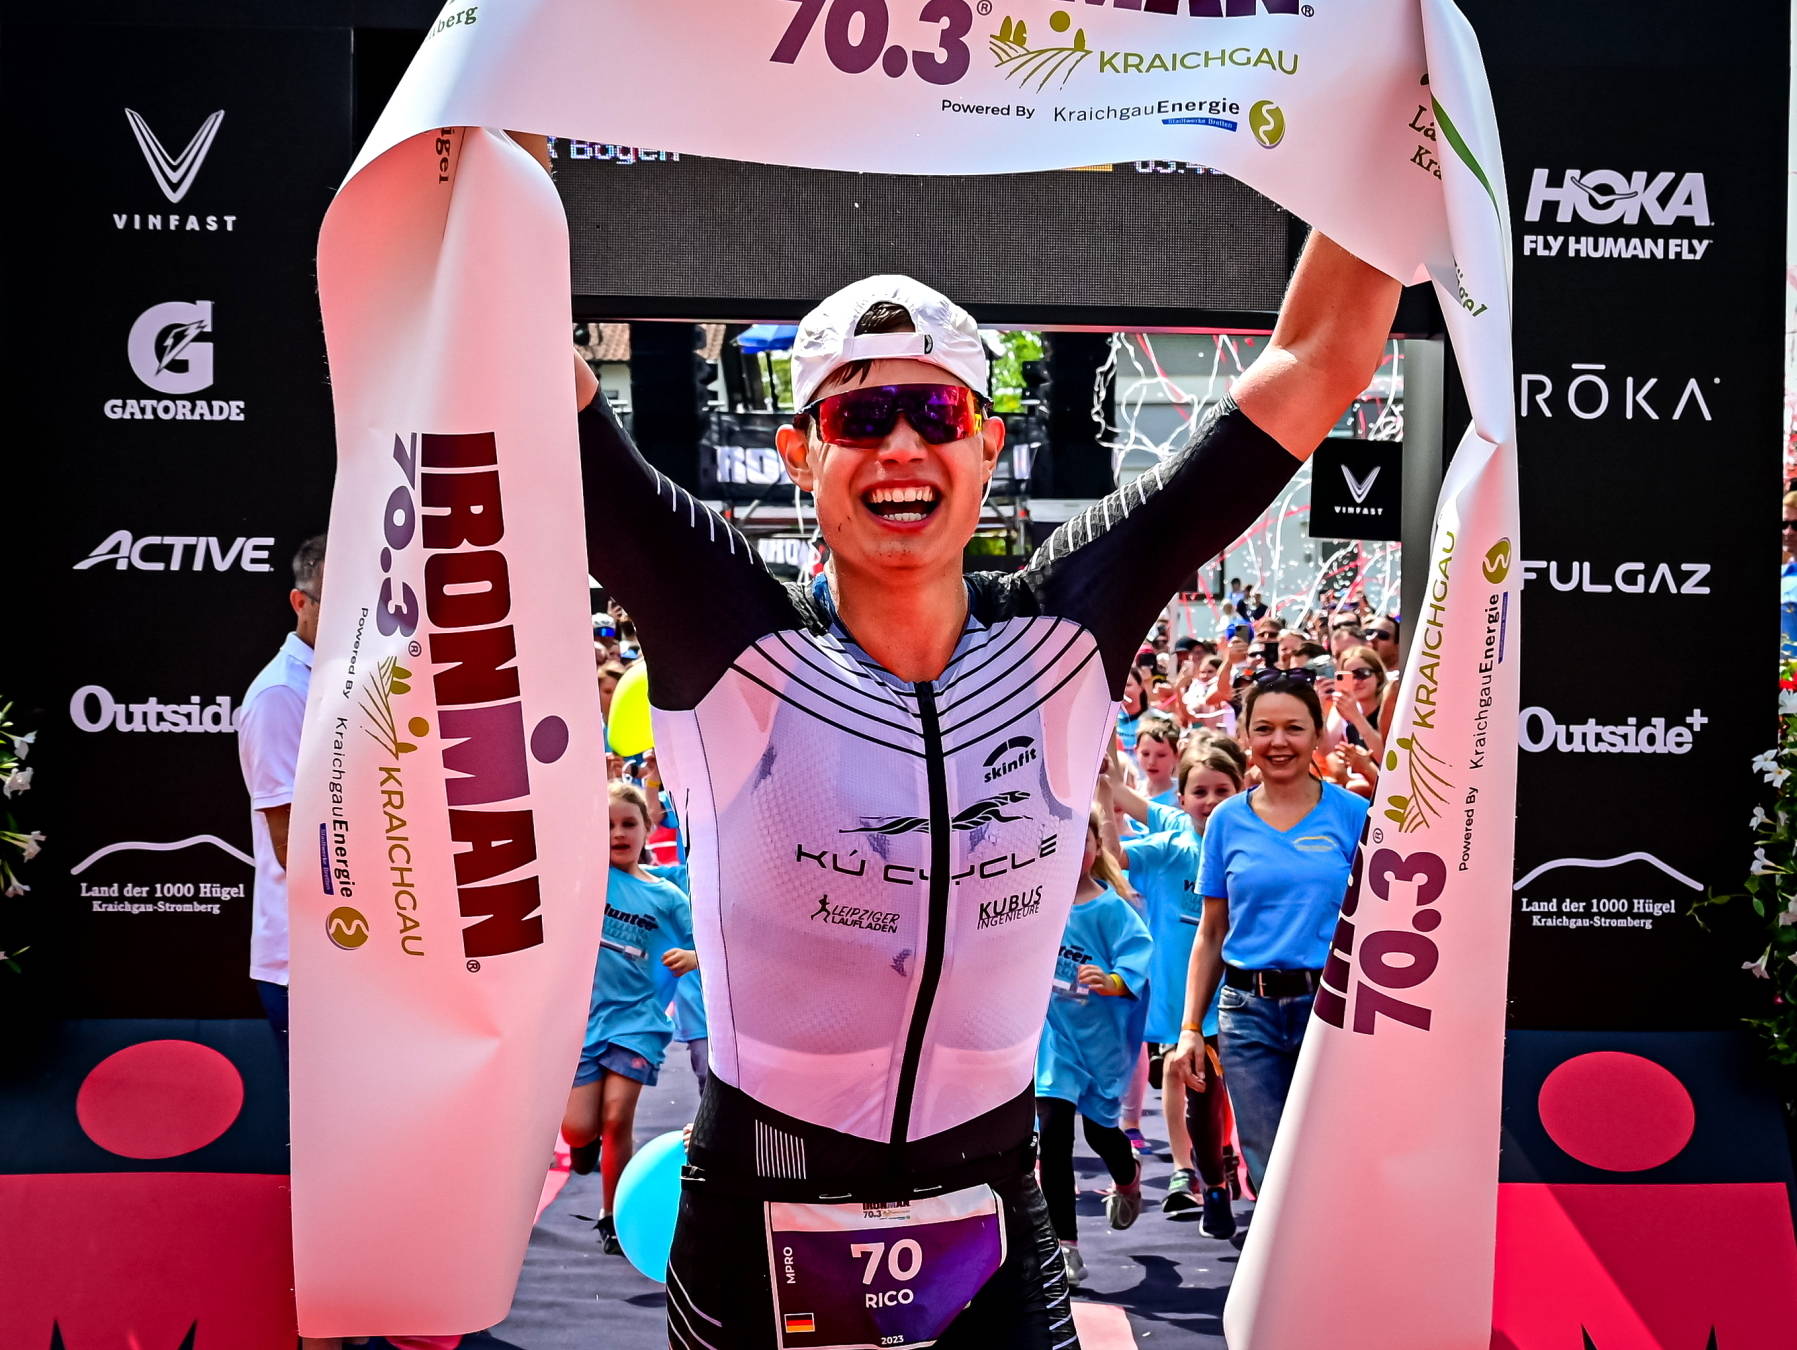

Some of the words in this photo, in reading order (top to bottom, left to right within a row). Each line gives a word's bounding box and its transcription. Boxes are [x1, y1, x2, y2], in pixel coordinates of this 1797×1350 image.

[1099, 47, 1299, 76] KRAICHGAU
[941, 99, 1011, 117] Powered
[1016, 105, 1036, 120] By
[1053, 97, 1240, 122] KraichgauEnergie
[1524, 168, 1711, 226] HOKA
[113, 214, 237, 231] VINFAST
[1523, 235, 1564, 256] FLY
[1568, 236, 1664, 259] HUMAN
[1668, 239, 1710, 260] FLY
[104, 400, 246, 421] GATORADE
[1334, 505, 1383, 515] VINFAST
[376, 432, 419, 638] 70.3
[72, 529, 275, 572] ACTIVE
[1520, 560, 1712, 594] FULGAZ
[347, 607, 369, 675] Powered
[1412, 530, 1456, 729] KRAICHGAU
[342, 680, 354, 700] By
[420, 431, 545, 958] IRONMAN
[1469, 593, 1500, 770] KraichgauEnergie
[984, 749, 1038, 783] skinfit
[328, 717, 354, 898] KraichgauEnergie
[1459, 807, 1475, 872] Powered
[1470, 787, 1479, 803] By
[378, 766, 425, 957] KRAICHGAU
[883, 833, 1058, 886] CYCLE
[80, 883, 119, 897] Land
[123, 883, 149, 897] der
[154, 884, 194, 897] 1000
[199, 883, 245, 900] Hügel
[978, 885, 1043, 921] KUBUS
[1521, 898, 1557, 912] Land
[1562, 898, 1586, 912] der
[1591, 899, 1628, 913] 1000
[1633, 899, 1676, 914] Hügel
[92, 901, 221, 914] Kraichgau-Stromberg
[832, 904, 901, 924] LEIPZIGER
[977, 904, 1040, 930] INGENIEURE
[1532, 915, 1653, 929] Kraichgau-Stromberg
[831, 915, 898, 933] LAUFLADEN
[1353, 848, 1447, 1036] 70.3
[863, 1210, 882, 1218] 70.3
[783, 1246, 797, 1284] MPRO
[850, 1238, 923, 1285] 70
[865, 1288, 914, 1308] RICO
[880, 1335, 904, 1345] 2023
